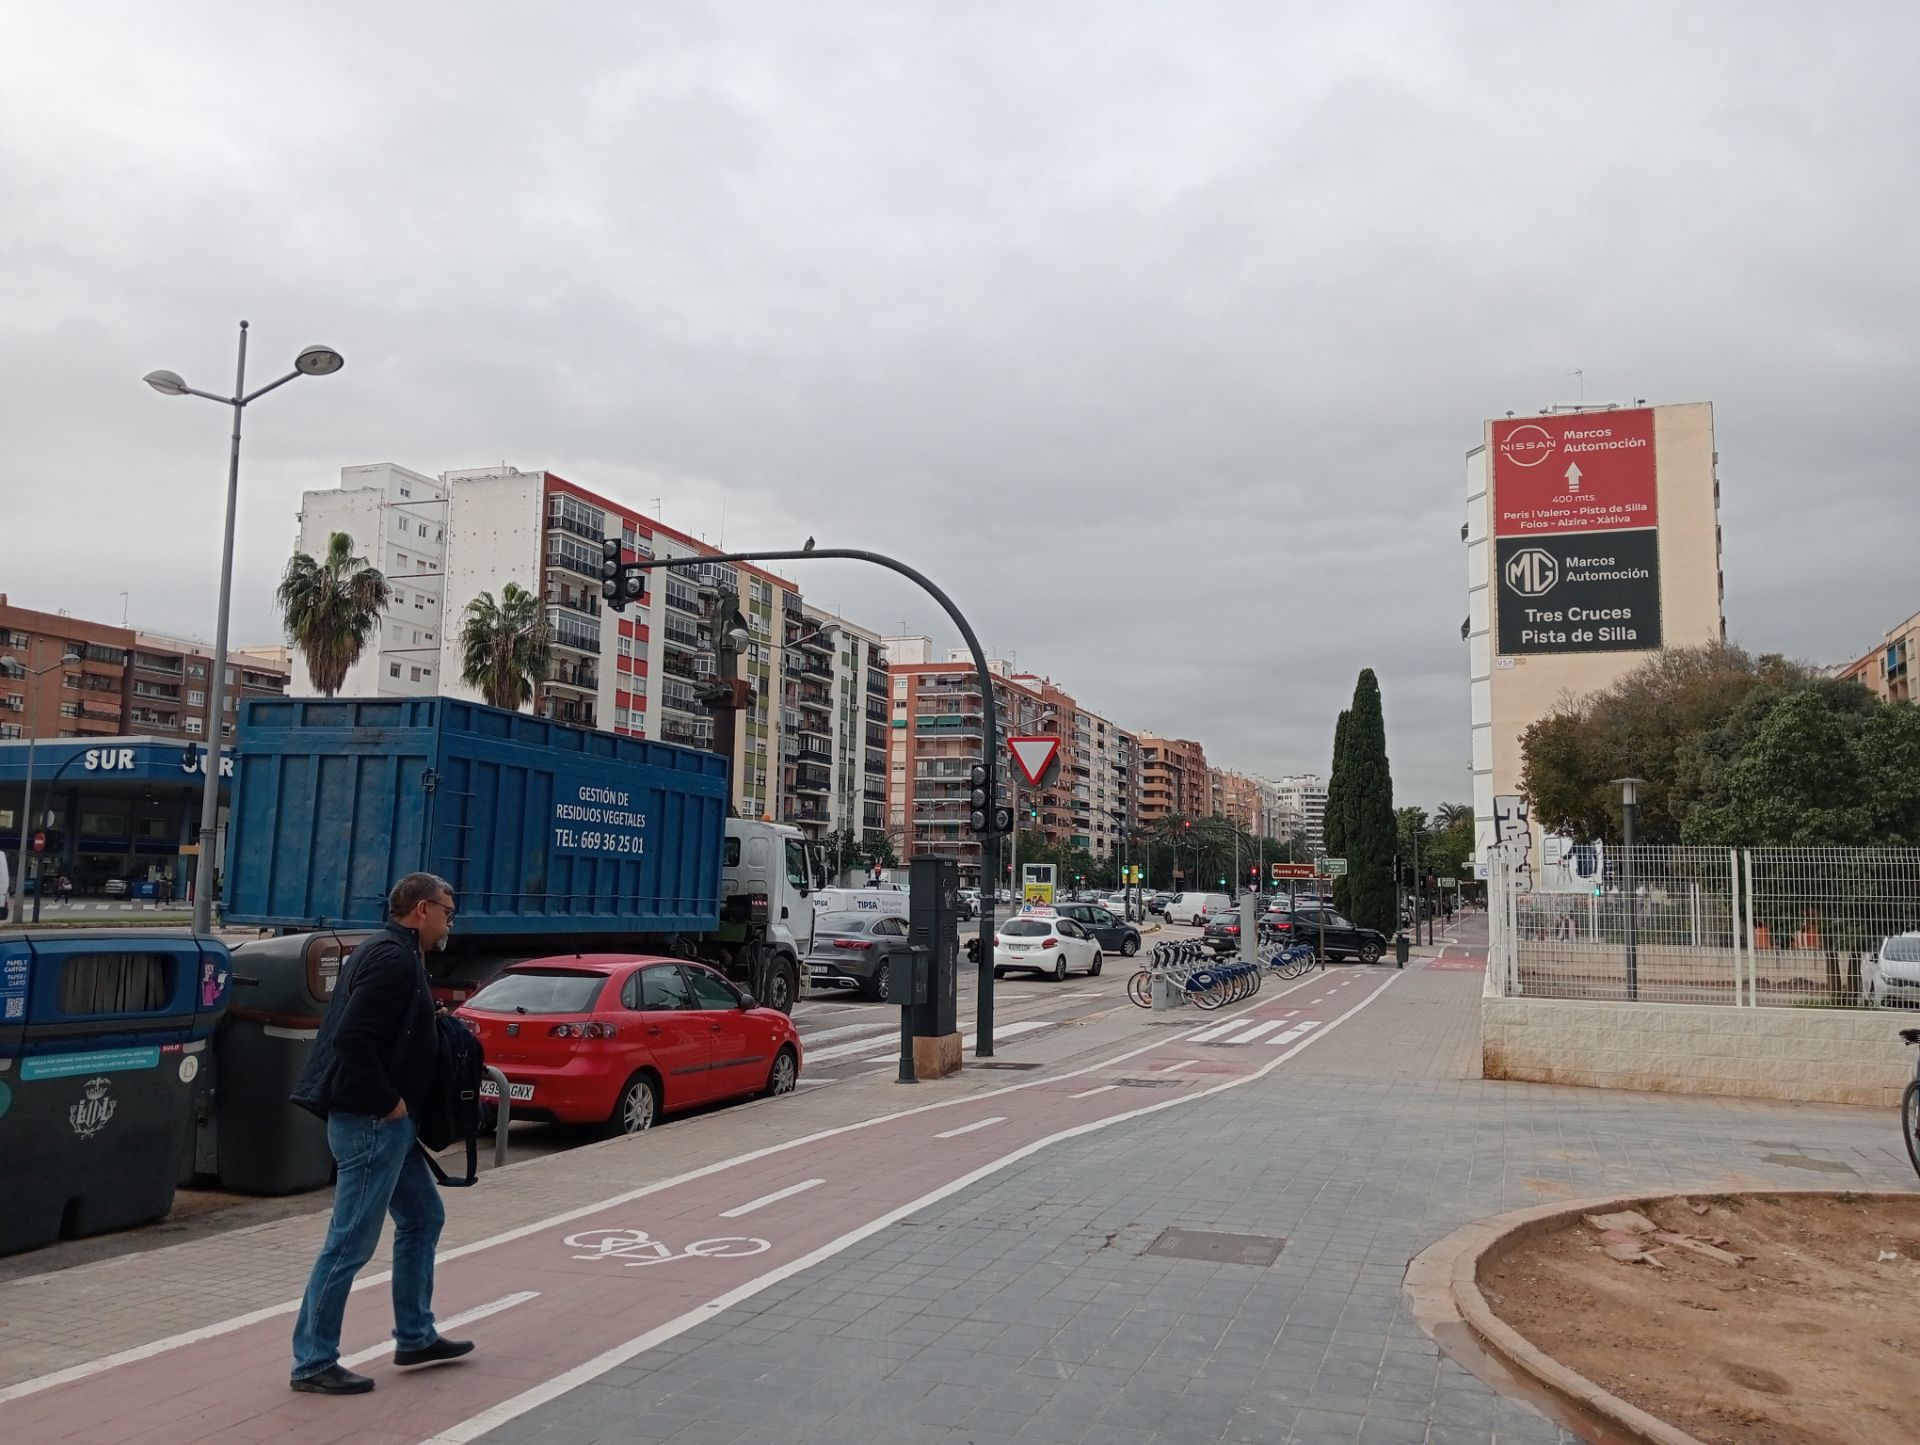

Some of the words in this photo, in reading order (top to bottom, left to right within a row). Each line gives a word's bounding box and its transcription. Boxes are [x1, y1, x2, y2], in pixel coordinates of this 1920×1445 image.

[1564, 428, 1612, 440] Marcos
[1500, 440, 1556, 452] NISSAN
[1564, 437, 1646, 453] Automoción
[1552, 495, 1573, 504] 400
[1504, 511, 1529, 520] Peris
[1536, 509, 1571, 518] Valero
[1579, 506, 1607, 515] Pista
[1608, 504, 1623, 513] de
[1624, 503, 1648, 512] Silla
[1557, 518, 1588, 527] Alzira
[1566, 556, 1615, 568] Marcos
[1510, 553, 1553, 592] MG
[1566, 568, 1649, 582] Automoción
[1524, 608, 1563, 623] Tres
[1568, 607, 1632, 621] Cruces
[1522, 630, 1566, 644] Pista
[1571, 628, 1593, 642] de
[1598, 626, 1637, 642] Silla
[84, 749, 135, 771] SUR
[579, 786, 616, 805] GESTIÓN
[617, 791, 629, 806] DE
[556, 803, 601, 823] RESIDUOS
[602, 809, 646, 828] VEGETALES
[555, 828, 578, 848] TEL:
[580, 830, 601, 849] 669
[602, 833, 616, 851] 36
[617, 835, 630, 853] 25
[631, 836, 644, 854] 01
[857, 901, 878, 909] TIPSA
[510, 1085, 533, 1099] GNX
